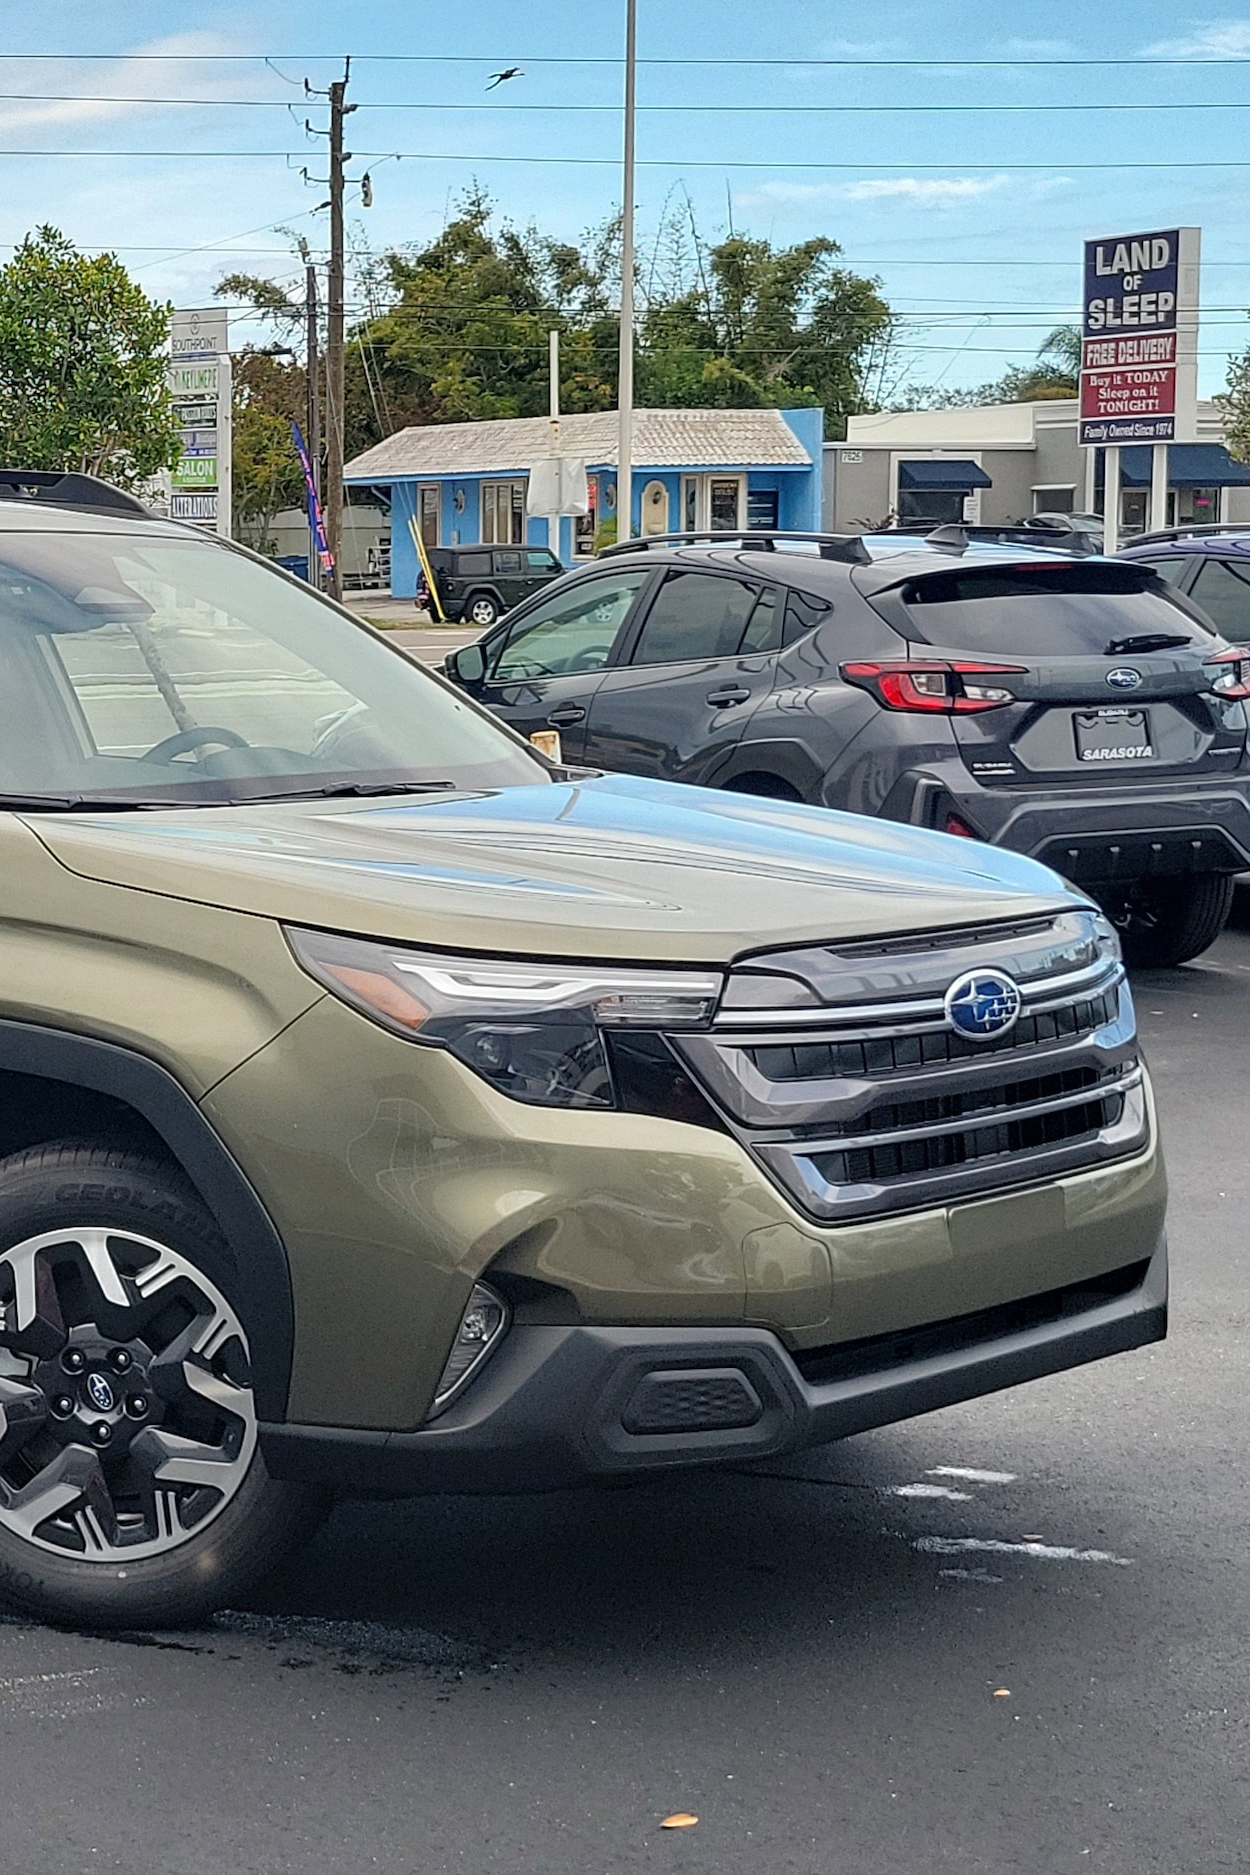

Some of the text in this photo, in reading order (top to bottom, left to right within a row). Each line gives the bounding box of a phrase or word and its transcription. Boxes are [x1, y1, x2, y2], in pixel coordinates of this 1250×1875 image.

[1095, 238, 1169, 276] LAND
[1123, 275, 1143, 291] OF
[1087, 291, 1174, 329] SLEEP
[1086, 337, 1172, 366] FREE DELIVERY
[1090, 370, 1168, 387] Buy it TODAY
[1098, 385, 1158, 400] Sleep on it
[1098, 399, 1159, 413] TONIGHT!
[1084, 422, 1172, 440] Family Owned Since 1974
[176, 461, 213, 476] SALON
[1082, 746, 1153, 760] SARASOTA
